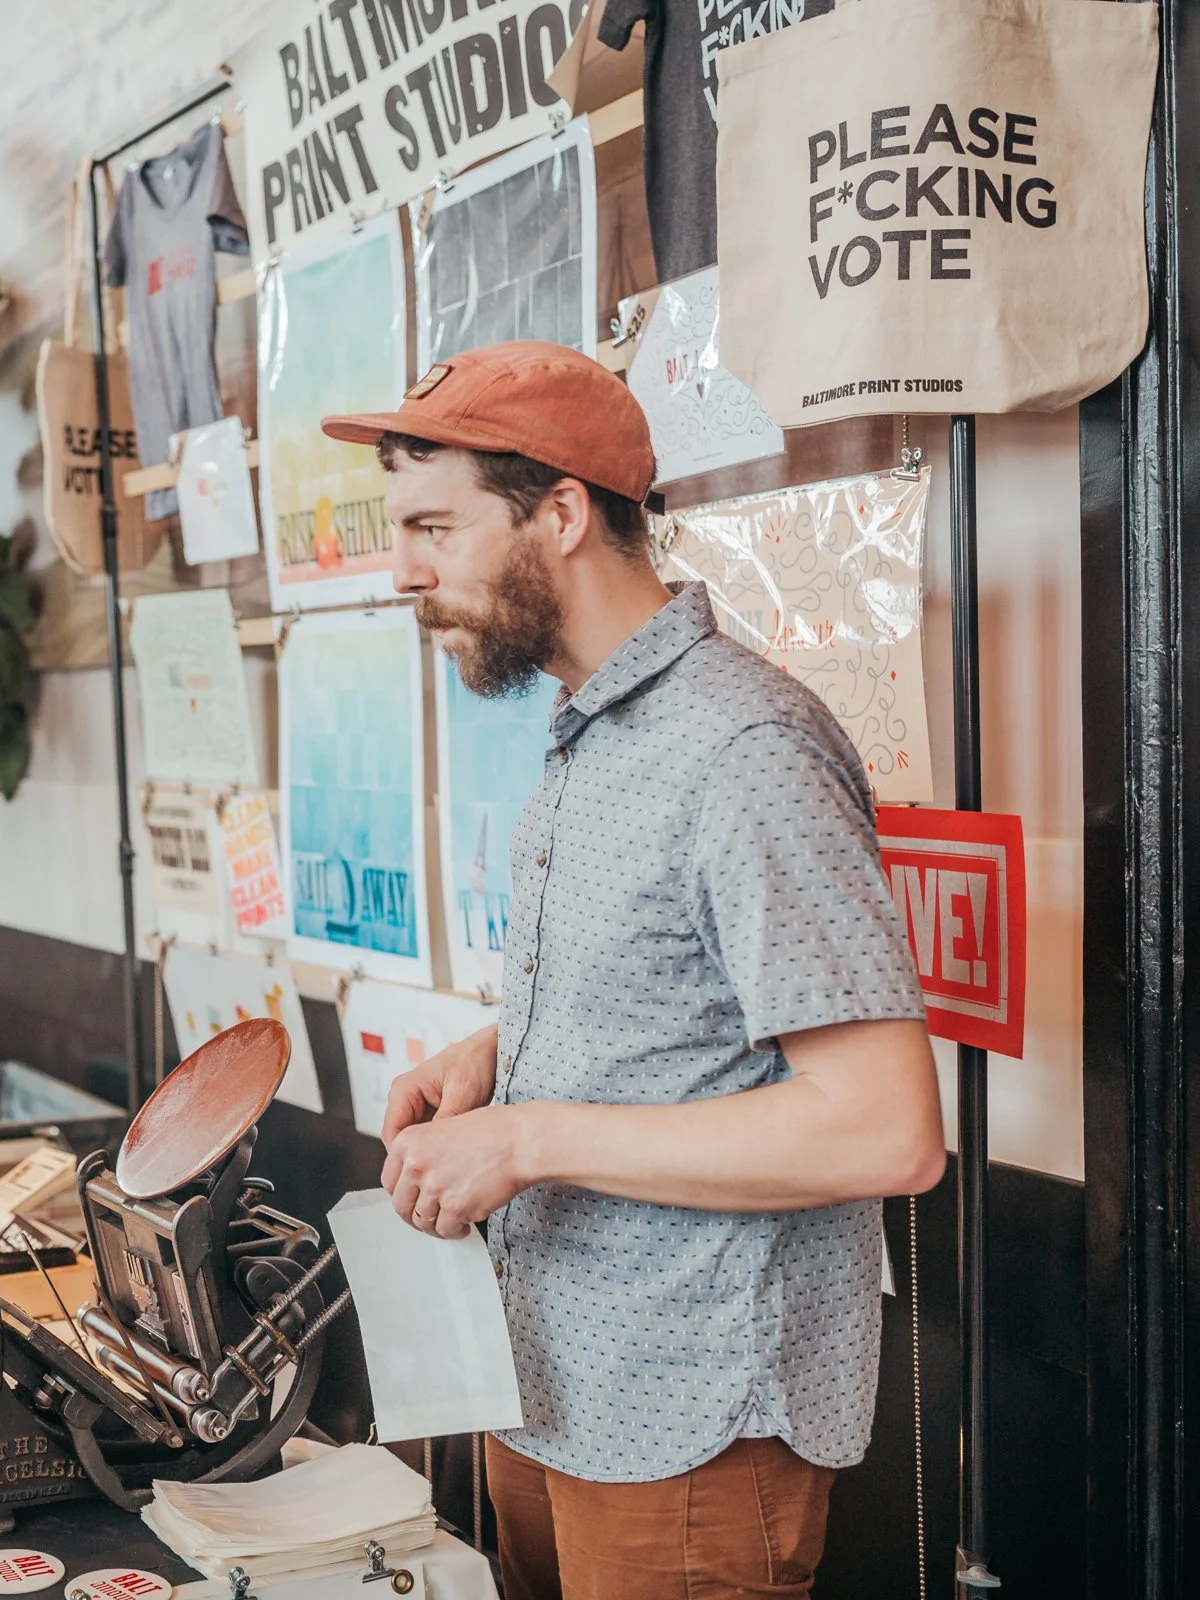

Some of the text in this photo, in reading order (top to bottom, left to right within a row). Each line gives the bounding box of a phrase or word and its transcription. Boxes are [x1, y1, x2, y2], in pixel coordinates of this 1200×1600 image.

[279, 0, 503, 130] BALTIM
[262, 104, 379, 245] PRINT
[808, 103, 1037, 184] PLEASE
[808, 228, 971, 300] VOTE
[802, 378, 963, 408] BALTIMORE PRINT STUDIOS
[881, 864, 988, 988] IVE!
[12, 1555, 56, 1577] BALT
[90, 1581, 136, 1600] amou
[110, 1573, 163, 1596] BALT
